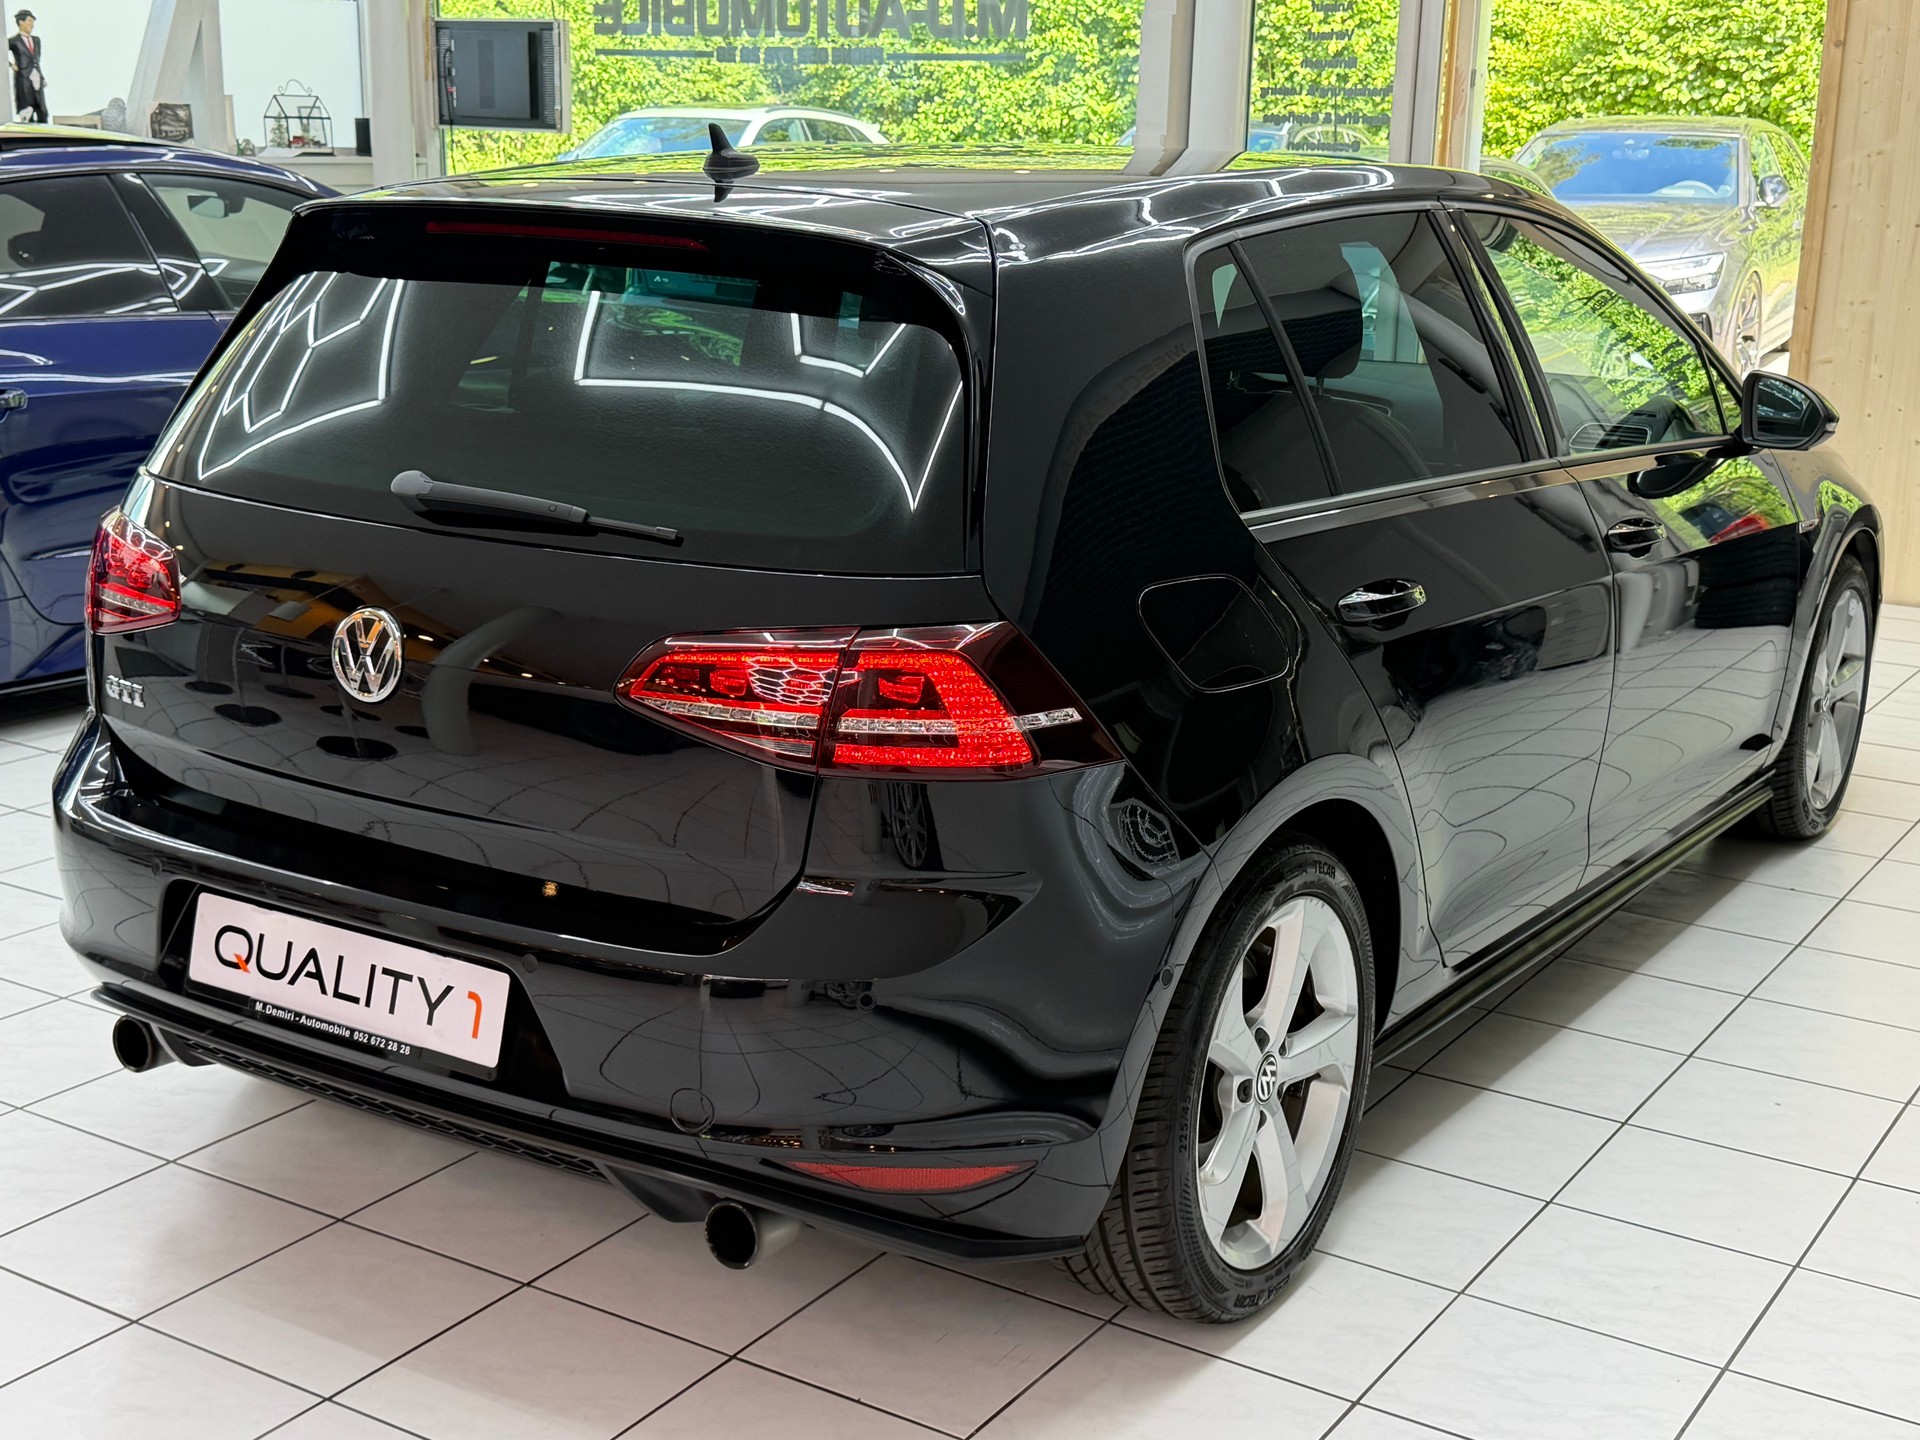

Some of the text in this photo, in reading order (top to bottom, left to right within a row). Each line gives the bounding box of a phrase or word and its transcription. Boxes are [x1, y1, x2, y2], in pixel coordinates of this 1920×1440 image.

[105, 675, 145, 708] GTI
[214, 924, 455, 1026] QUALITY
[300, 1014, 350, 1038] Automobile
[353, 1030, 368, 1044] 052
[370, 1035, 385, 1049] 672
[387, 1039, 398, 1052] 28
[399, 1043, 411, 1056] 28
